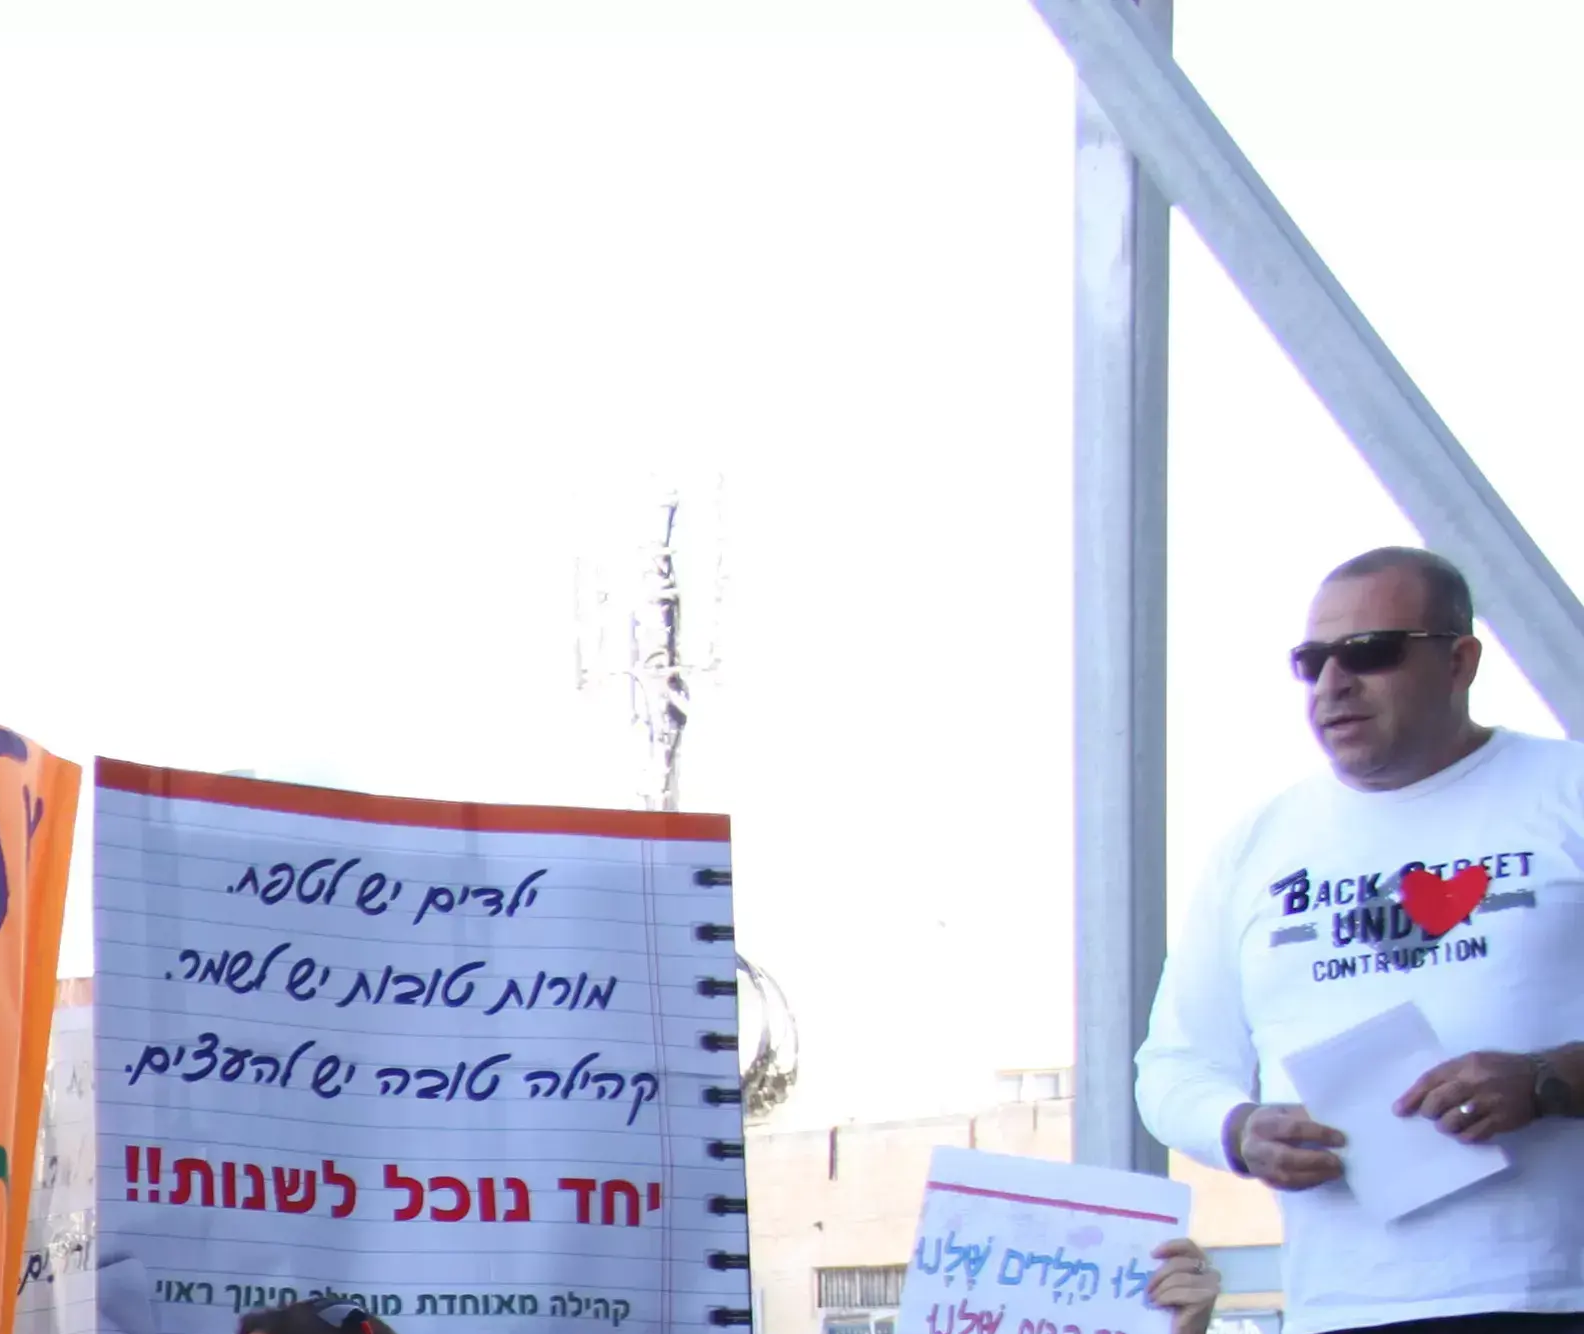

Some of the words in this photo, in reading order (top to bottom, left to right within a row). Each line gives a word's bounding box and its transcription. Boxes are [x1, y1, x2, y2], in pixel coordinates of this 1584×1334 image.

[355, 871, 403, 916] יש
[412, 868, 548, 926] ילדים
[285, 956, 330, 1002] יש
[335, 960, 487, 1008] טובות
[483, 970, 618, 1016] מורות
[311, 1054, 356, 1099] יש
[376, 1052, 513, 1103] טובה
[523, 1051, 660, 1126] קהילה
[382, 1163, 532, 1224] נוכל
[557, 1176, 661, 1228] יחד
[155, 1277, 215, 1307] ראוי
[414, 1290, 540, 1317] מאוחדת
[549, 1290, 632, 1328] קהילה
